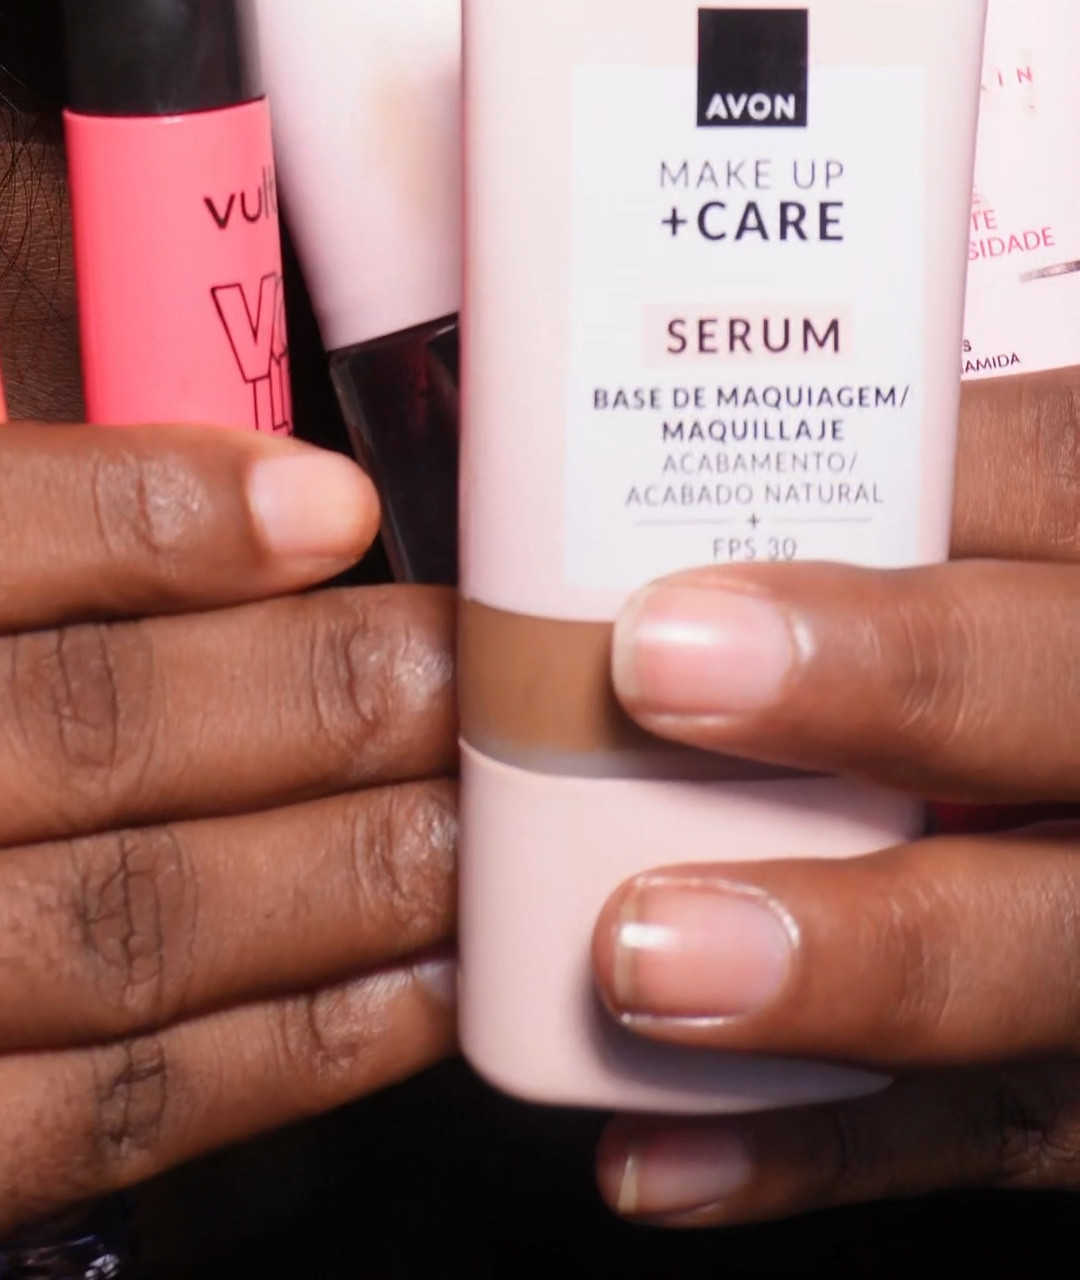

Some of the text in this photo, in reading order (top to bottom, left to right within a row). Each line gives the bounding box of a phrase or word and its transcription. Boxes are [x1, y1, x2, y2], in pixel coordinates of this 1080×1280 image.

[980, 66, 1033, 91] IN
[705, 92, 796, 121] AVON
[660, 159, 845, 190] MAKE UP
[661, 200, 844, 242] +CARE
[666, 317, 840, 355] SERUM
[961, 352, 1021, 374] AMIDA
[593, 385, 909, 410] BASE DE MAQUIAGEM/
[662, 419, 844, 444] MAQUILLAJE
[662, 451, 858, 475] ACABAMENTO/
[624, 482, 884, 507] ACABADO NATURAL
[713, 537, 797, 562] FPS 30
